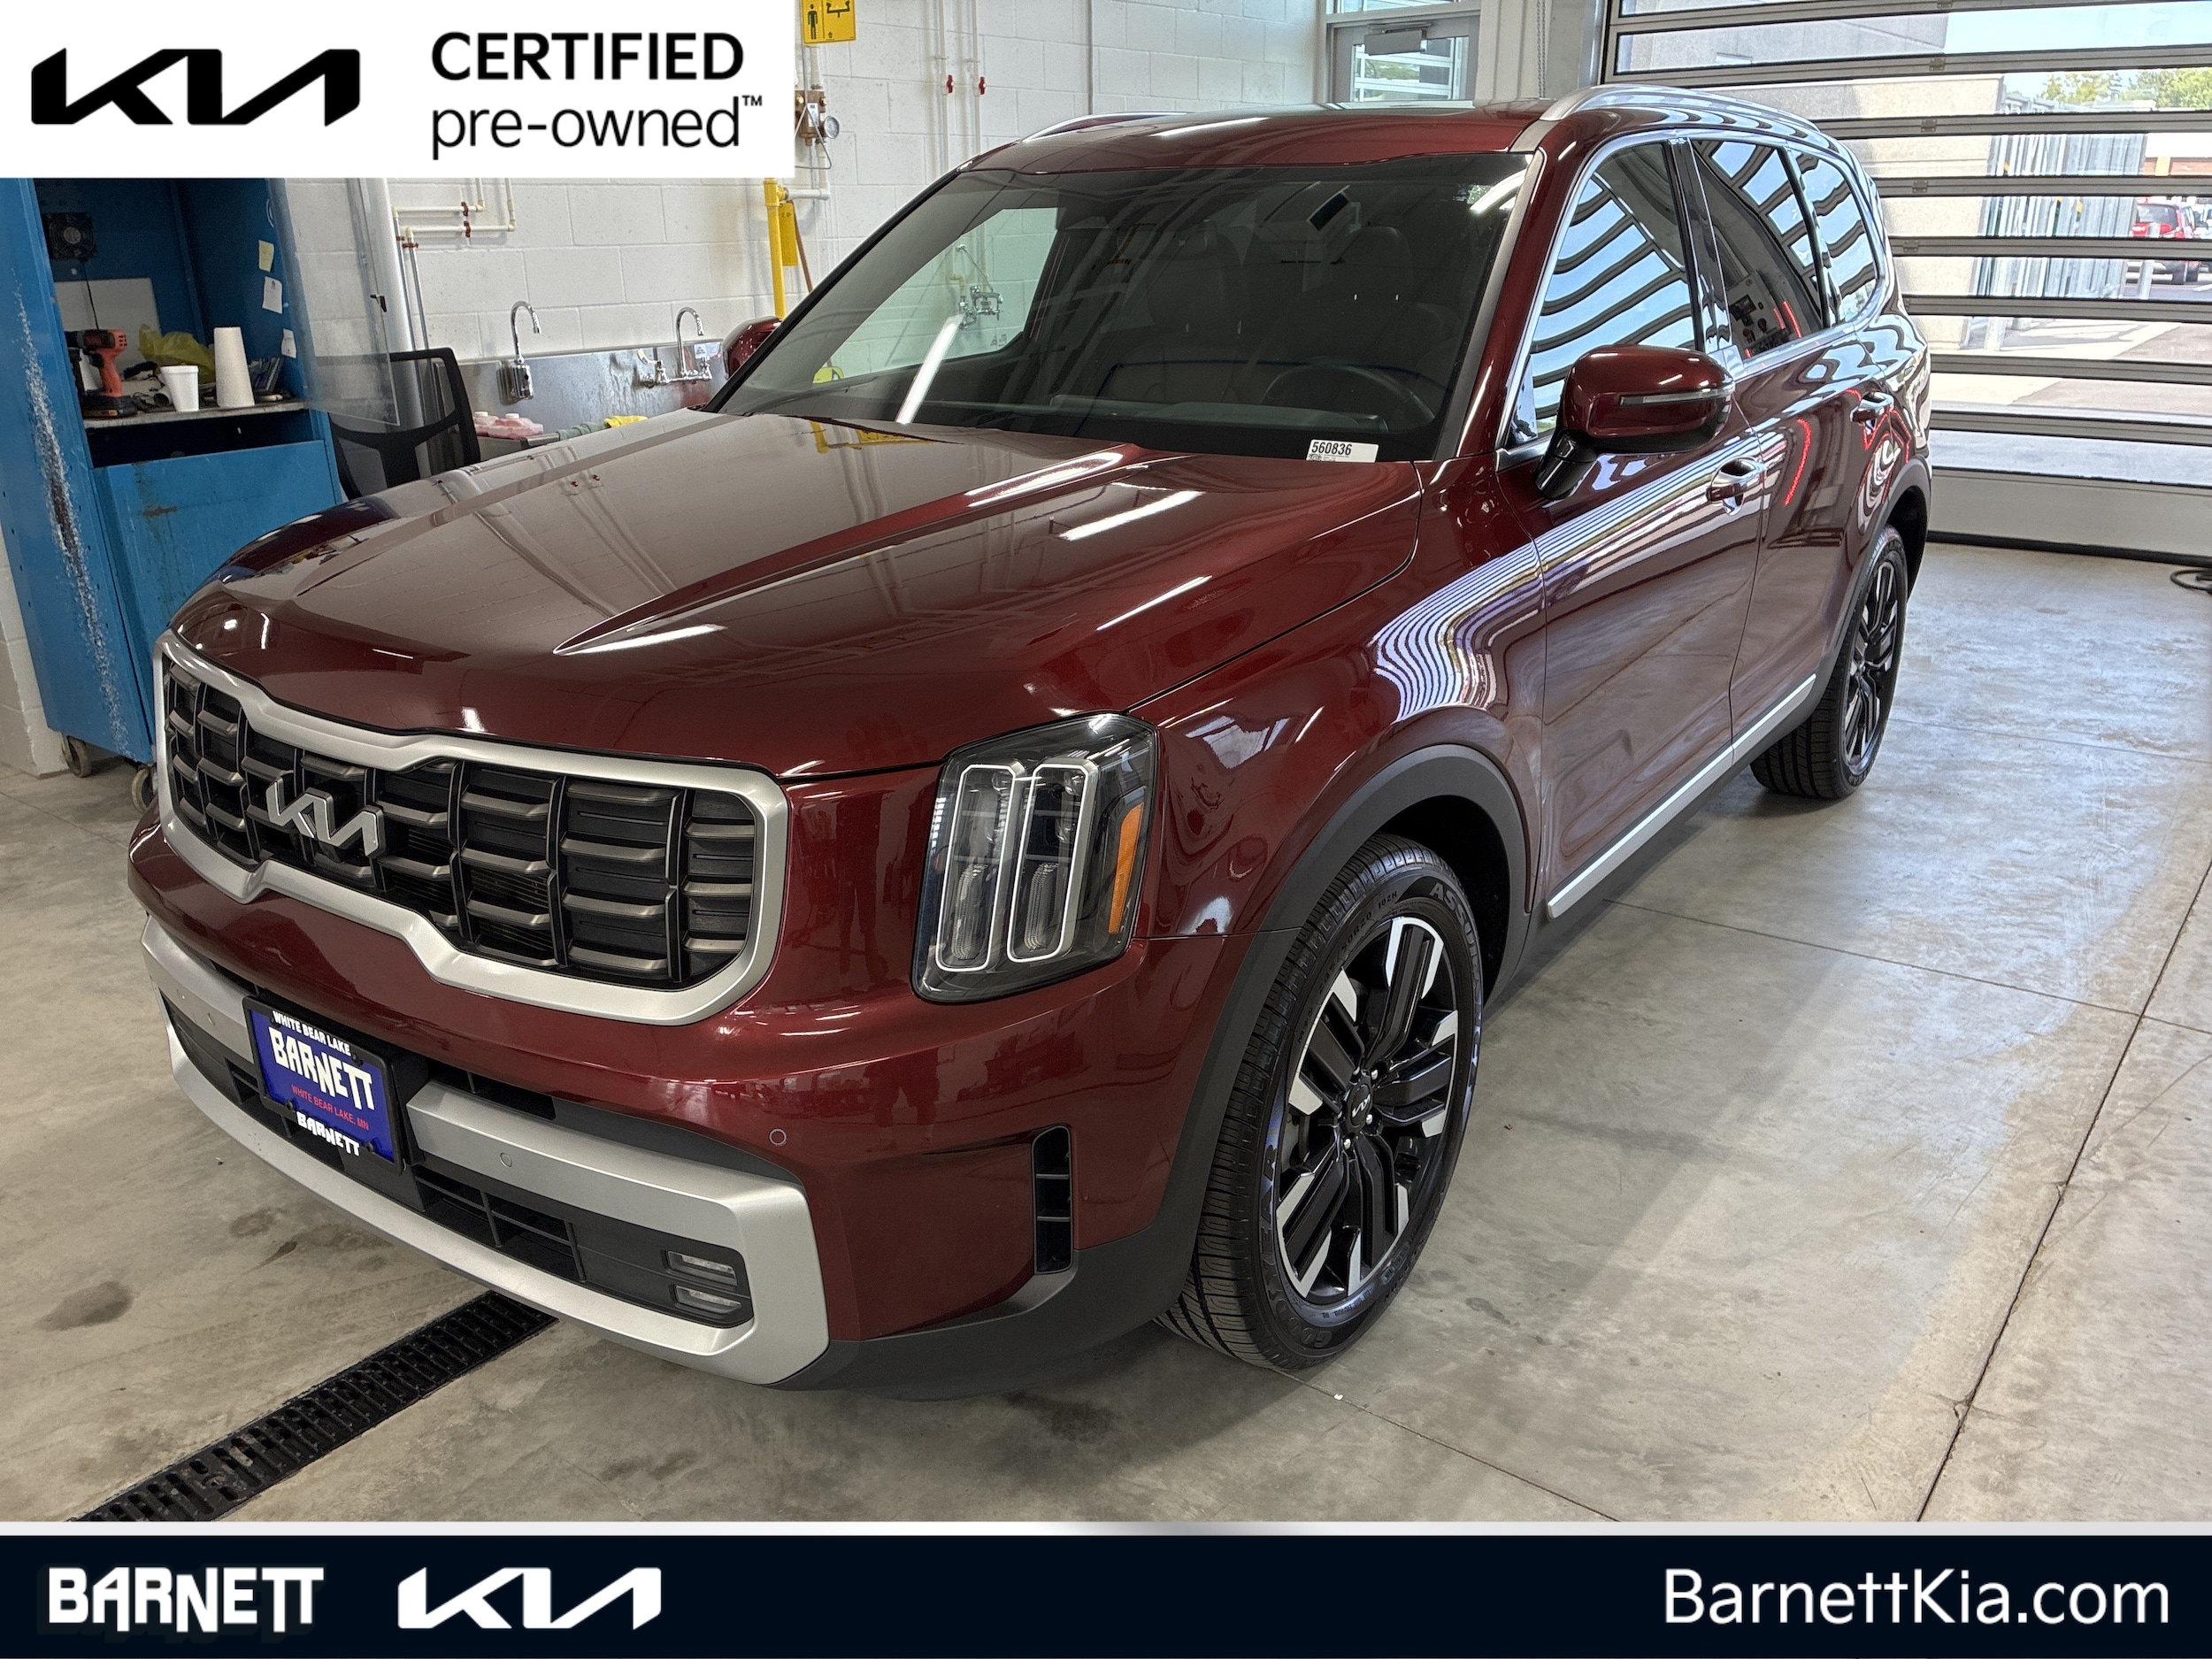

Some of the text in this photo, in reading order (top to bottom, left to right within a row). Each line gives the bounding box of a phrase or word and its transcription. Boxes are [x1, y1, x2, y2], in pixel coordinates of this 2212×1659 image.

[1311, 442, 1352, 455] 560836
[1378, 891, 1398, 909] 102H
[273, 1010, 350, 1056] WHITE BEAR LAKE
[268, 1026, 375, 1110] BARNETT
[292, 1086, 312, 1102] WHITE
[314, 1098, 333, 1112] BEAR
[296, 1111, 360, 1156] BARNETT
